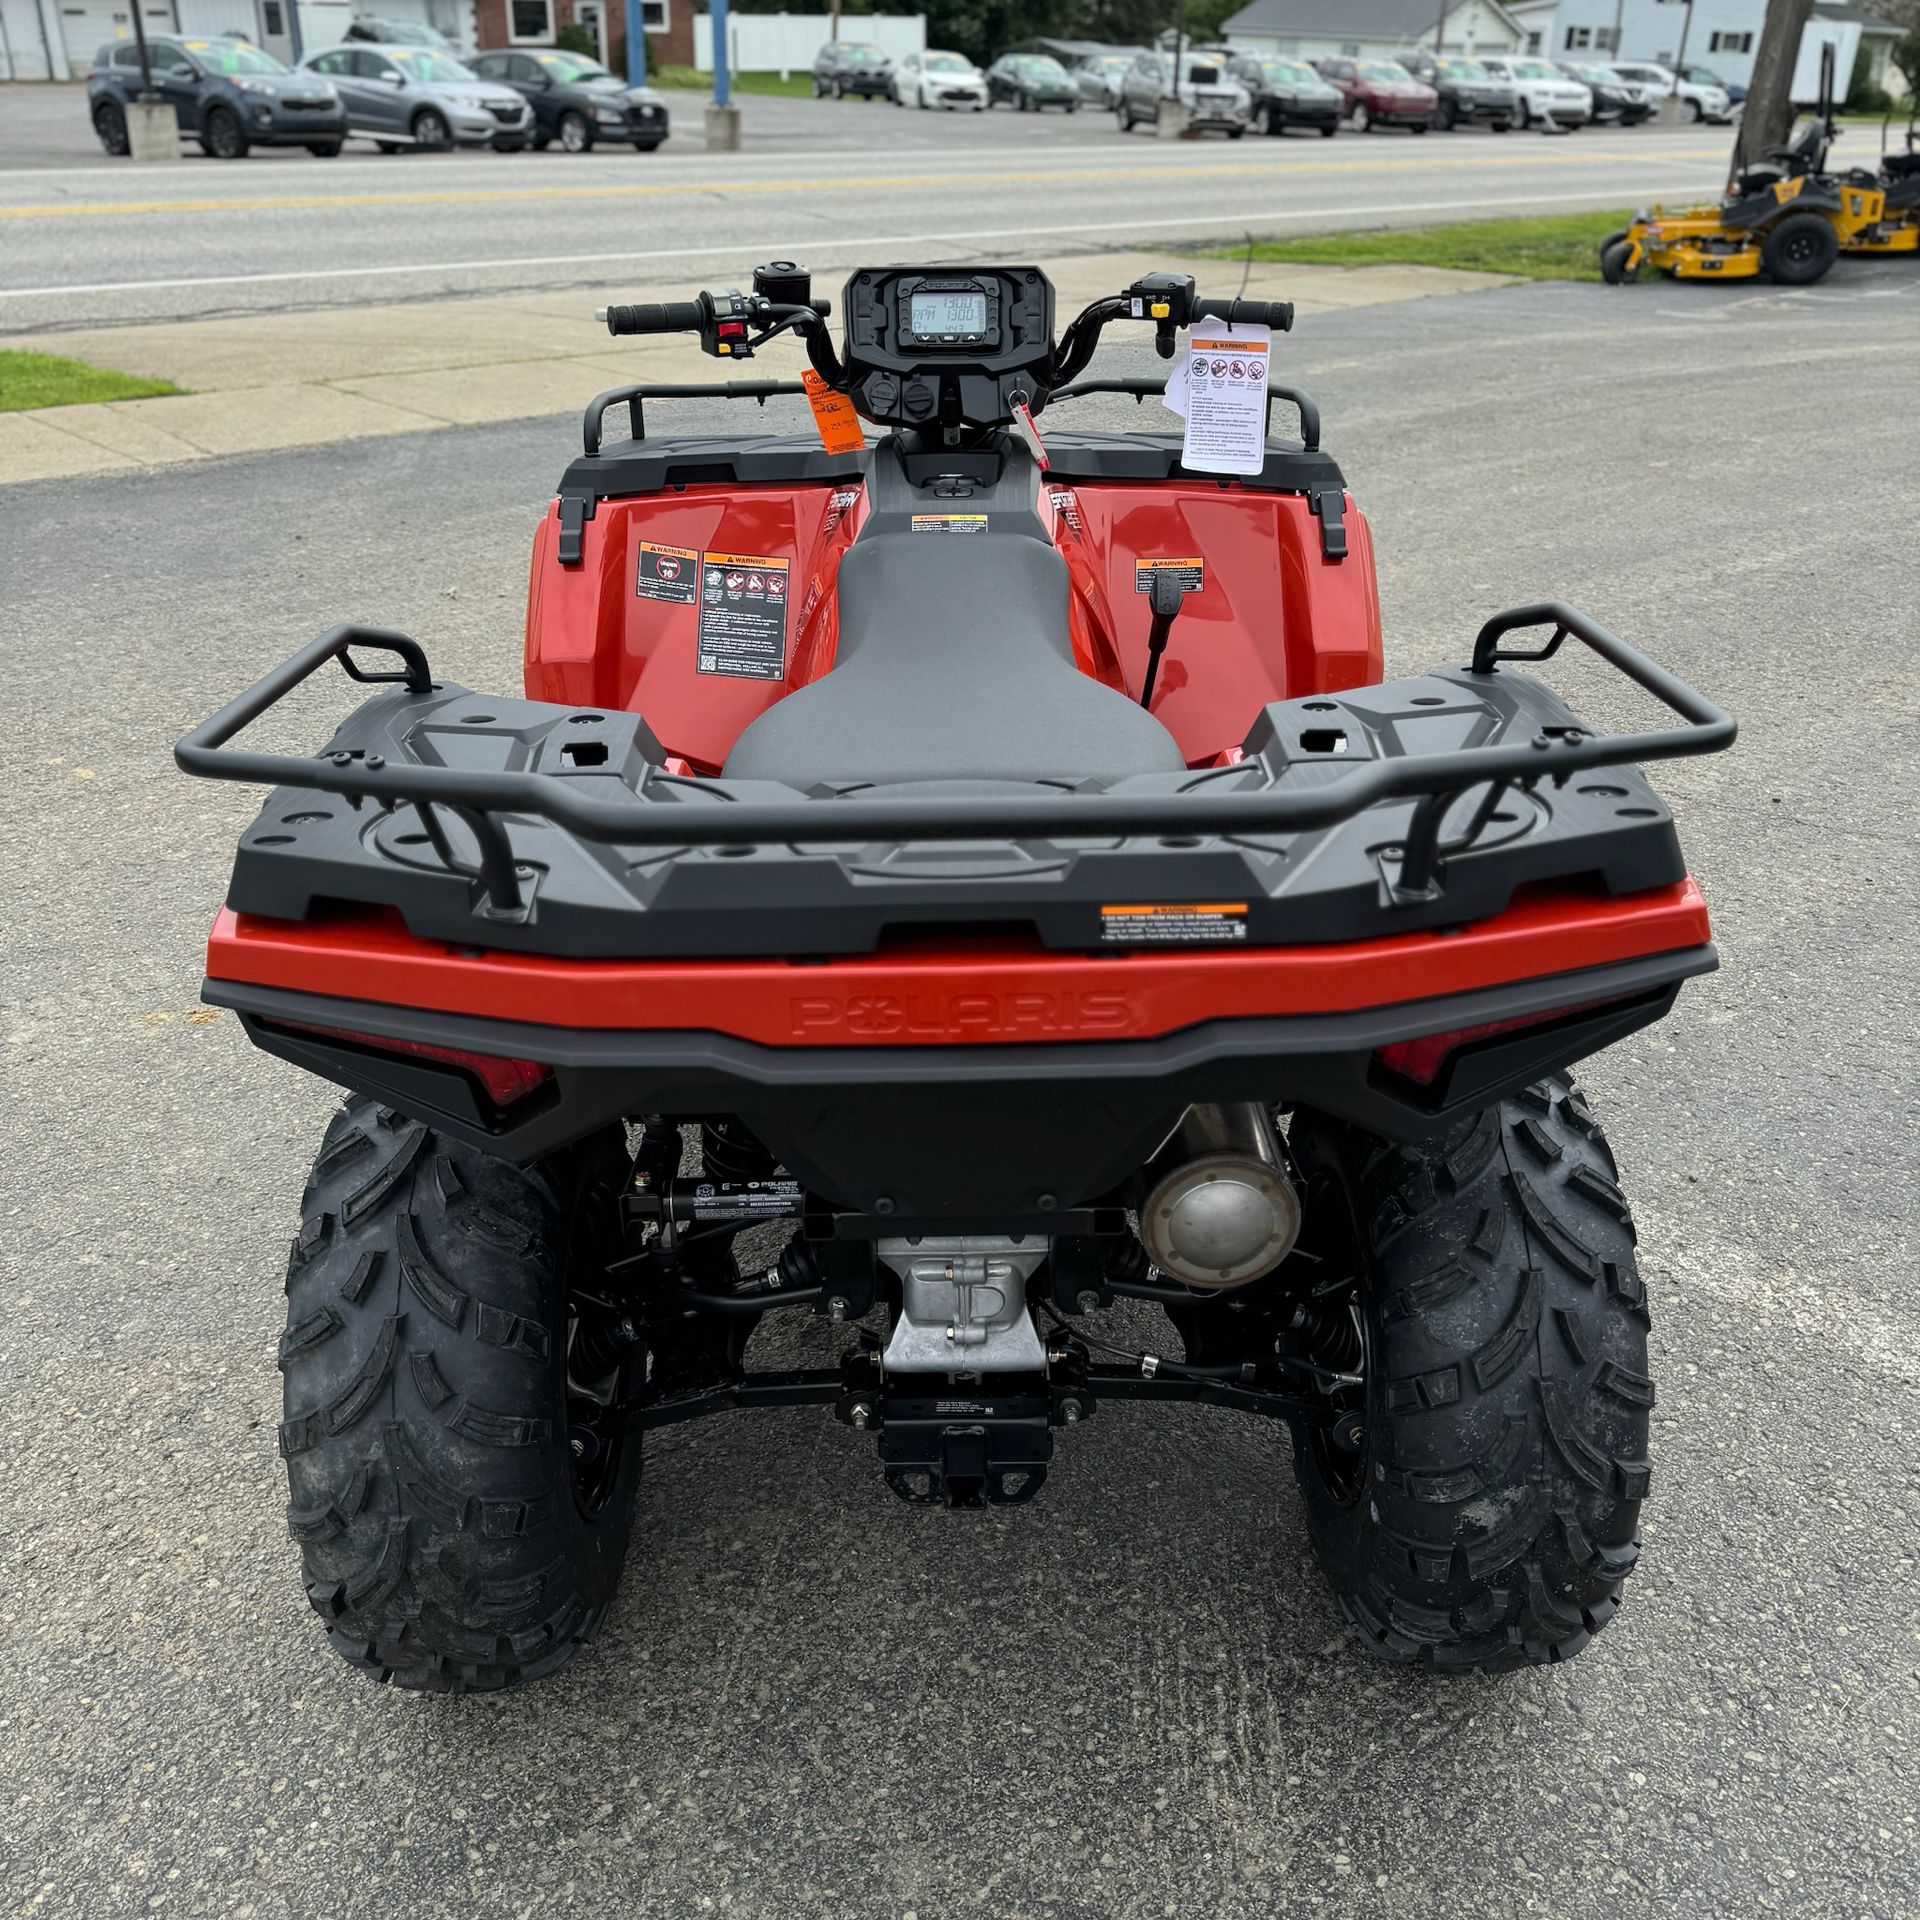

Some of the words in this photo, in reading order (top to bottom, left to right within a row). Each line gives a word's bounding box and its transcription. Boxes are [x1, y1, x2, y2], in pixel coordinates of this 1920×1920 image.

[913, 309, 936, 320] RPM
[948, 309, 974, 321] 1300
[657, 546, 687, 556] WARNING
[736, 557, 766, 565] WARNING
[663, 569, 674, 578] 16
[790, 990, 1131, 1035] POLARIS
